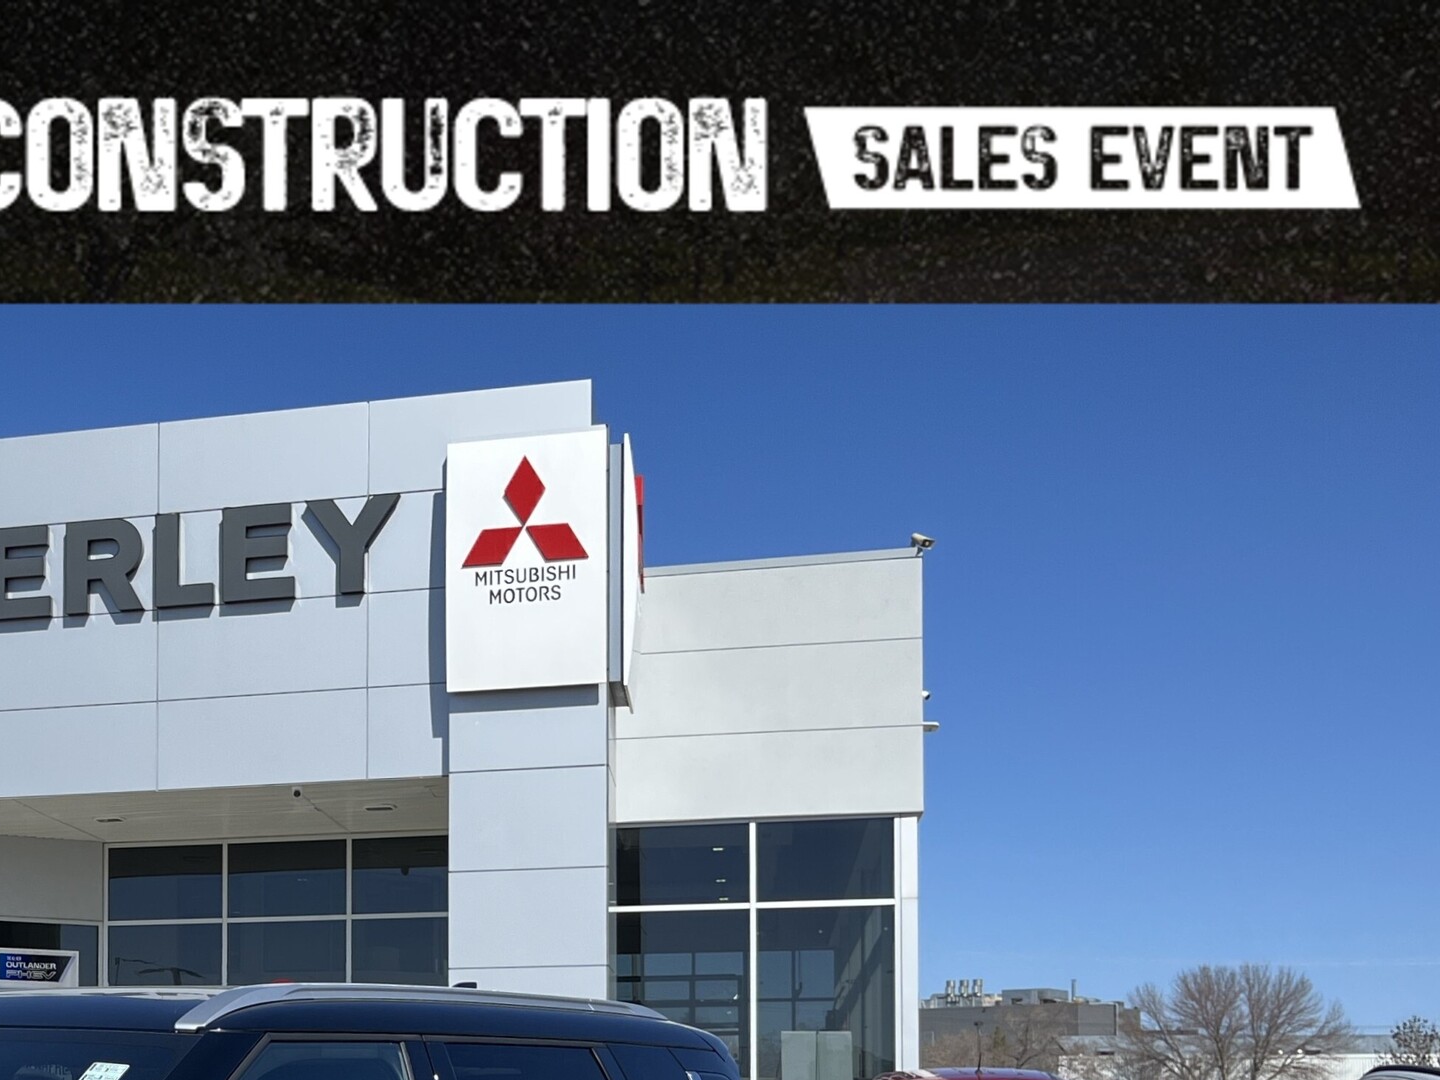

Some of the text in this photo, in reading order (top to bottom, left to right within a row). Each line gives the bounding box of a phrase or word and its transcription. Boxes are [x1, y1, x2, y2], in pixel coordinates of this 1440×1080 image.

[475, 564, 577, 587] MITSUBISHI
[489, 585, 562, 605] MOTORS
[6, 961, 57, 970] OUTLANDER
[6, 970, 57, 980] PHEV
